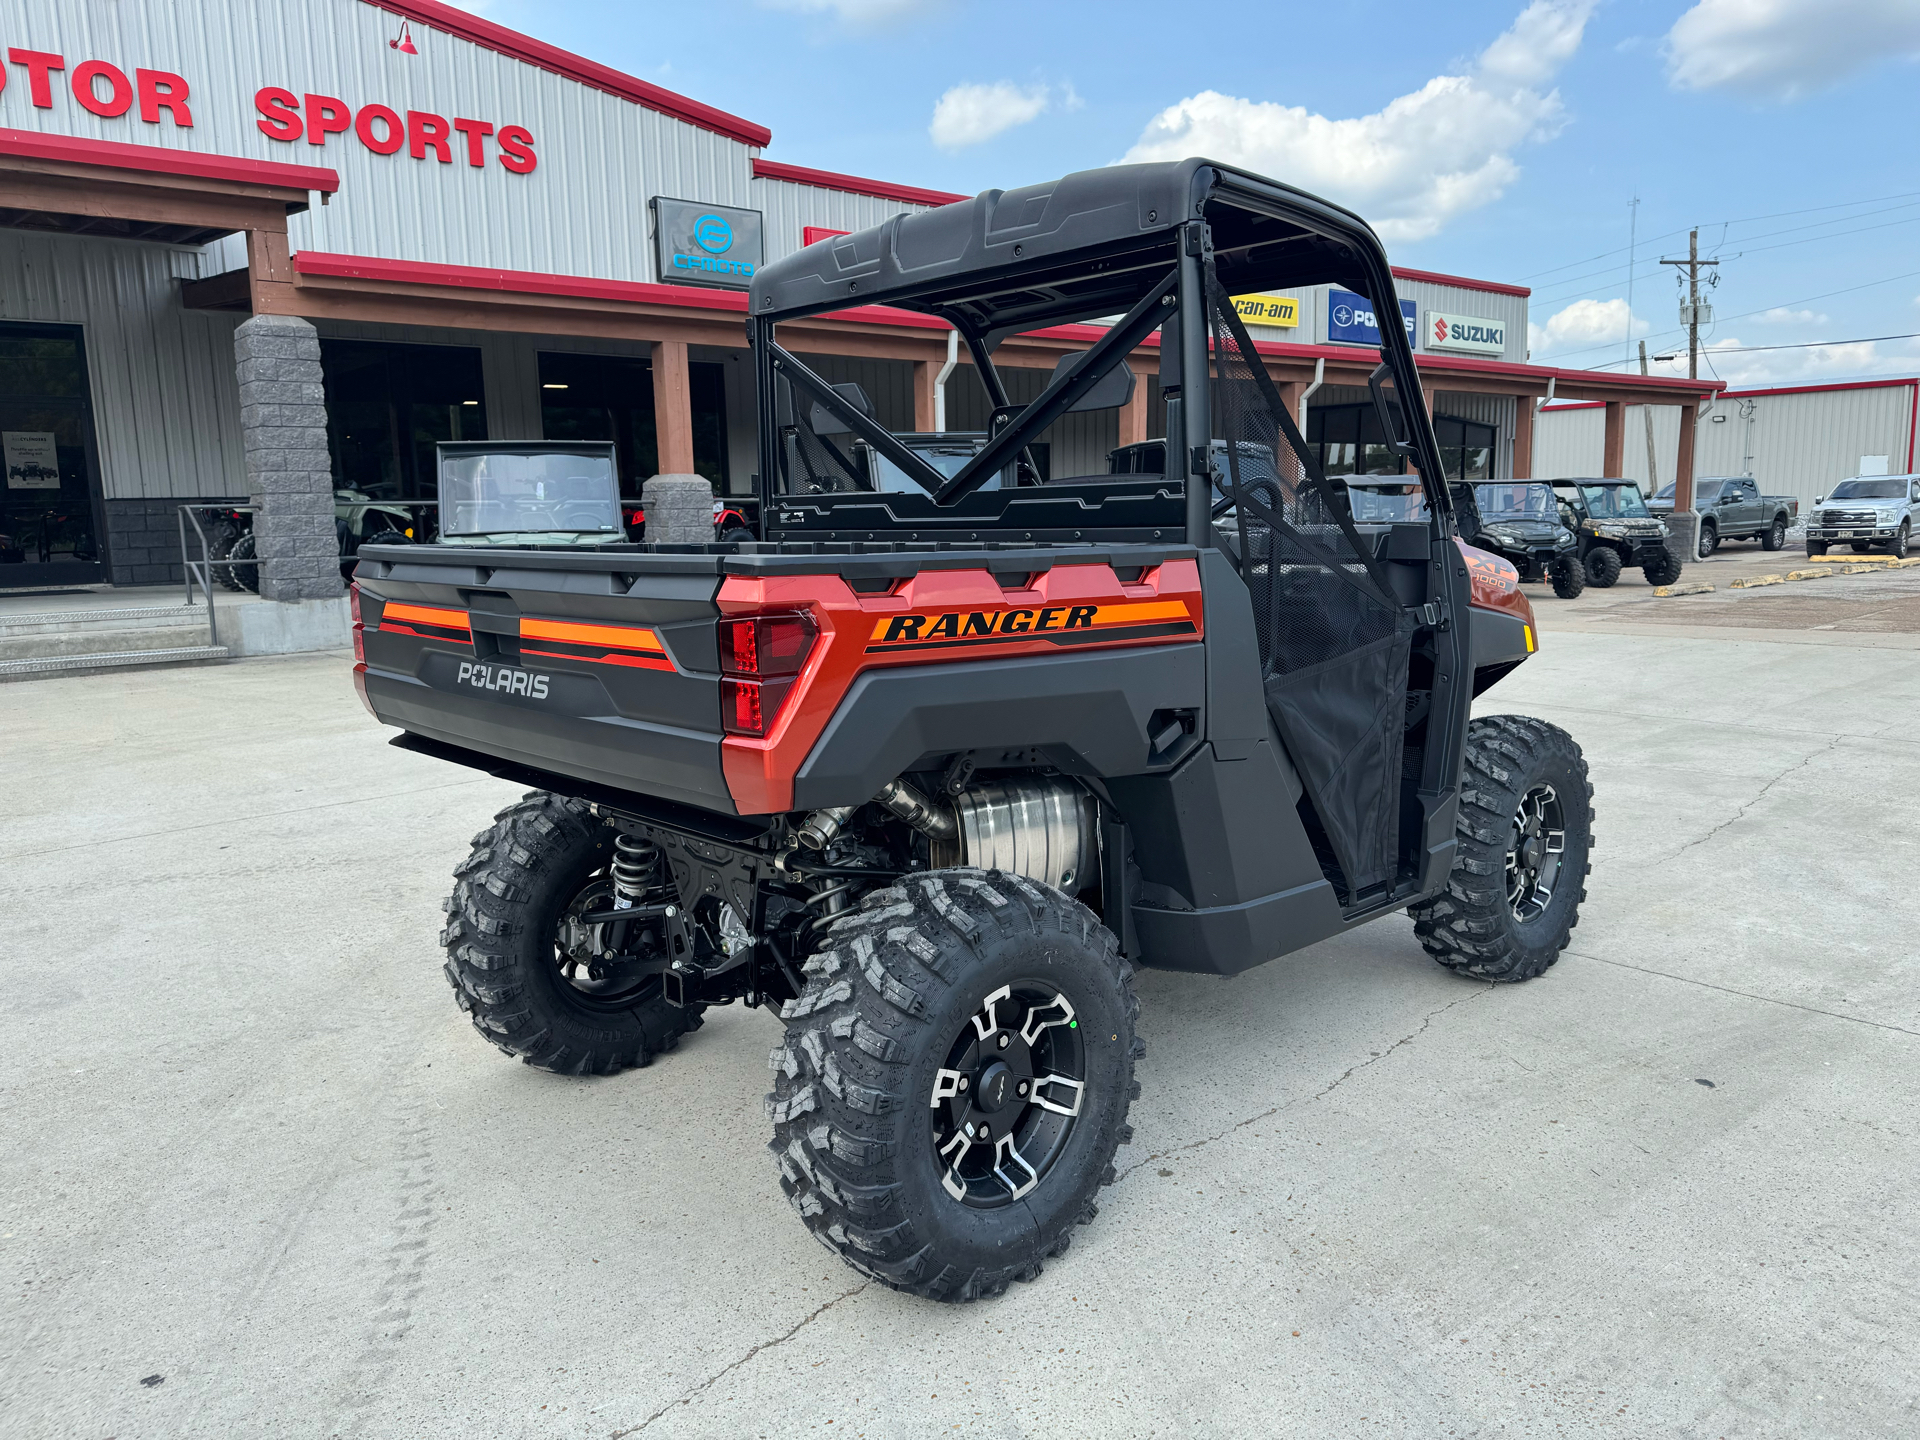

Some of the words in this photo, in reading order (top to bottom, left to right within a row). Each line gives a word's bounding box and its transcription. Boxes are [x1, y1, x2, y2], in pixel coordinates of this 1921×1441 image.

[0, 46, 194, 127] TOR
[255, 86, 537, 174] SPORTS
[673, 253, 755, 277] CFMOTO
[1234, 299, 1294, 319] can-am
[1451, 323, 1503, 345] SUZUKI
[1472, 555, 1512, 575] XP
[1475, 573, 1506, 589] 1000
[882, 605, 1098, 642] RANGER
[457, 661, 550, 700] POLARIS
